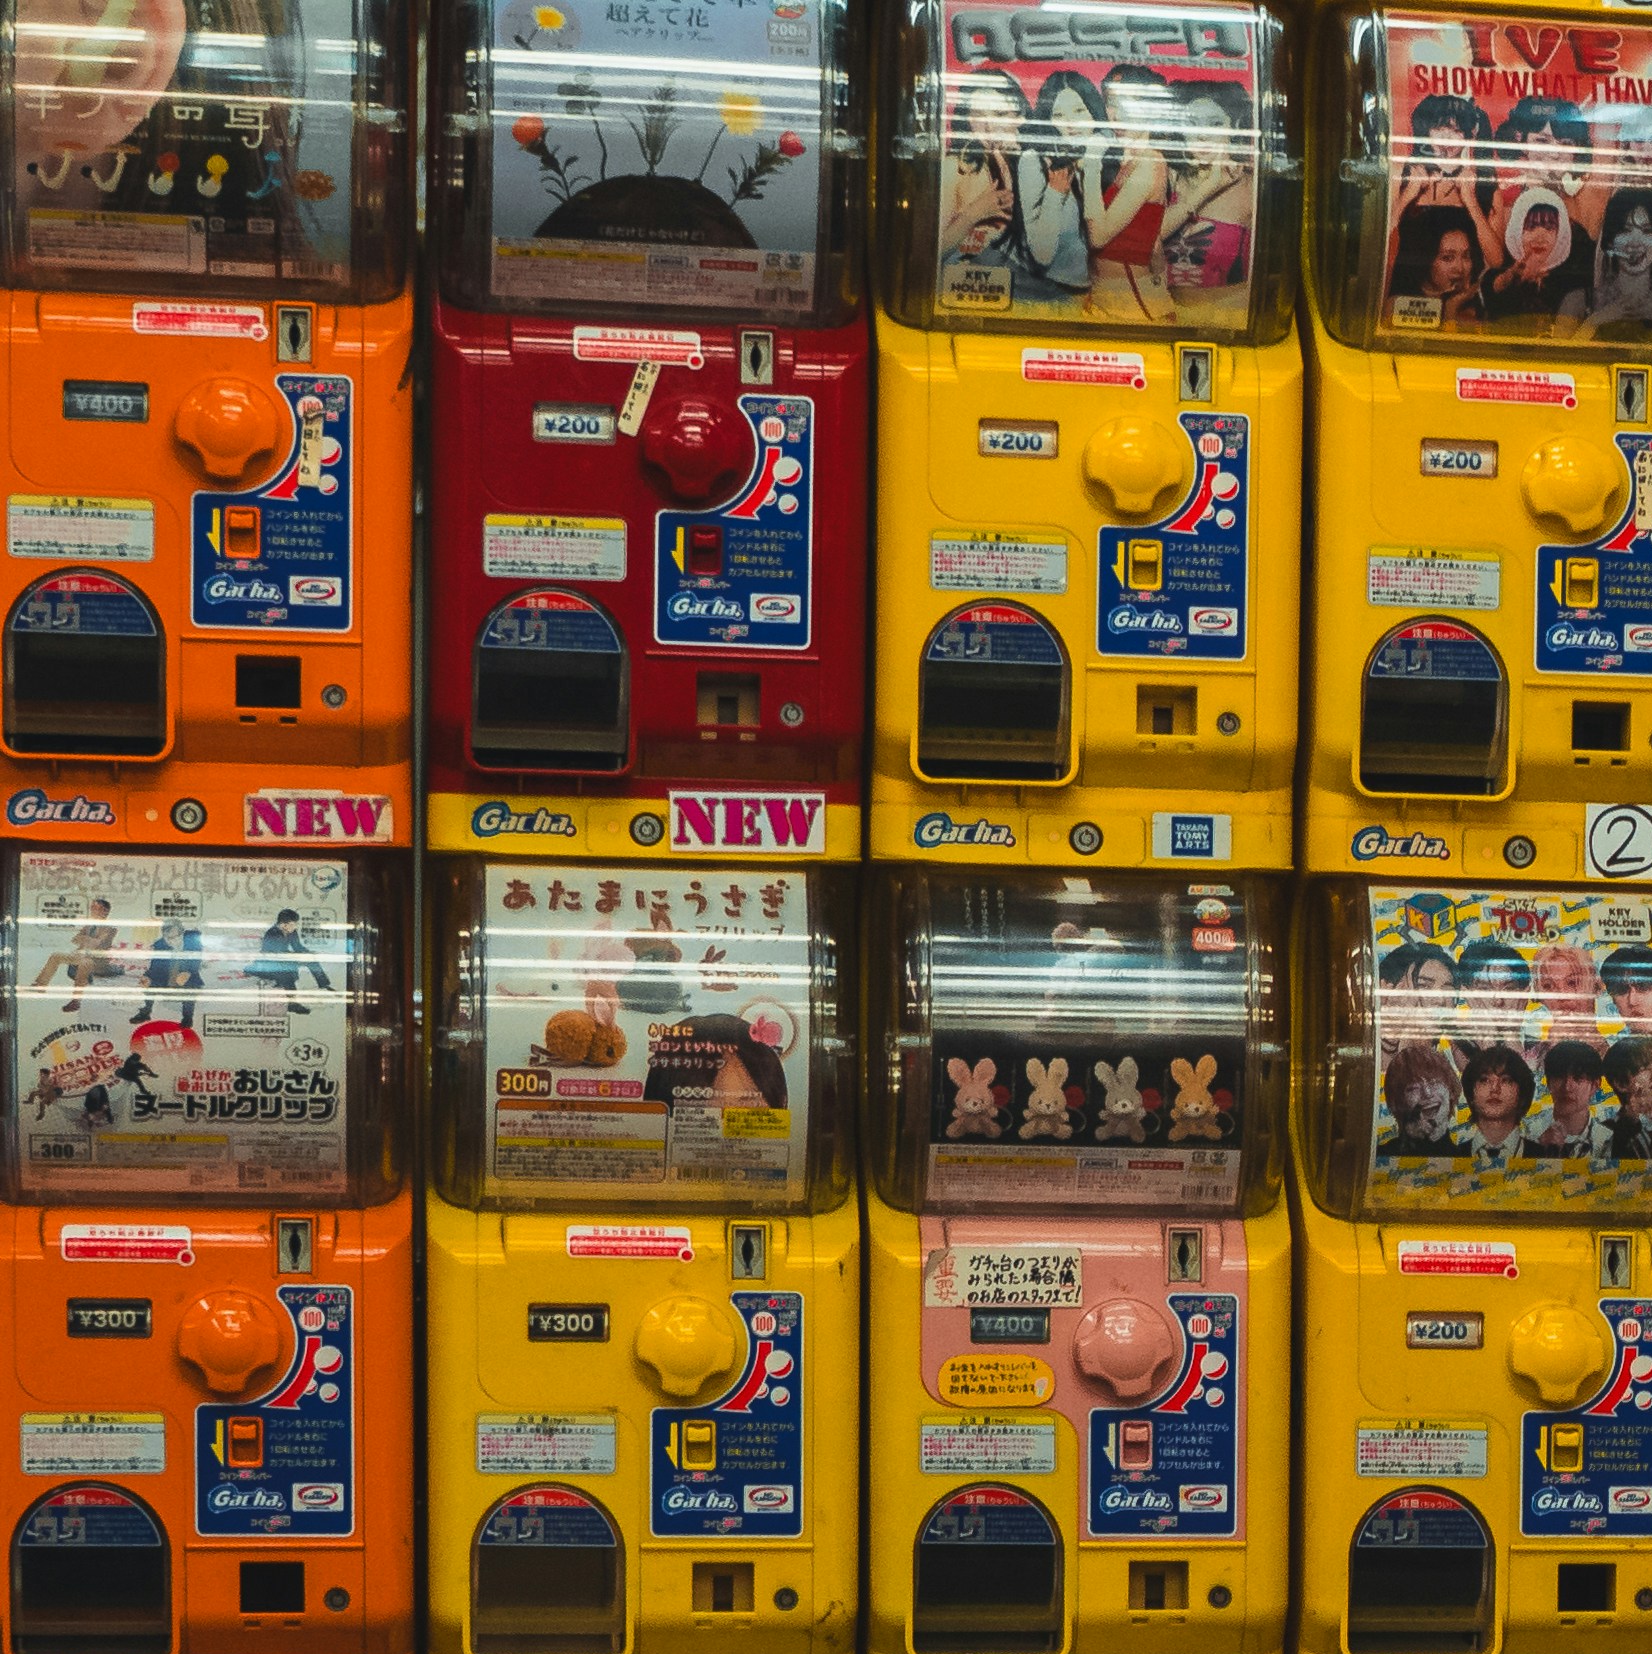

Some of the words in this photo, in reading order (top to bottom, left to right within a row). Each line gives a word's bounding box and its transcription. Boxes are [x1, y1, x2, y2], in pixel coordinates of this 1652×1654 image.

[1464, 21, 1623, 76] IVE
[1413, 64, 1500, 98] SHOW
[1503, 68, 1583, 101] WHAT
[74, 394, 134, 415] ¥400
[544, 417, 601, 436] ¥200
[988, 432, 1043, 452] ¥200
[1429, 451, 1483, 471] ¥200
[208, 576, 283, 604] Gacha.
[1109, 606, 1182, 633] Gacha.
[8, 792, 115, 824] Gacha.
[245, 797, 387, 838] NEW
[672, 799, 821, 845] NEW
[916, 815, 1017, 847] Gacha.
[502, 878, 791, 919] あたまにうさぎ
[1492, 908, 1549, 932] TOY
[1598, 919, 1645, 928] HOLDER
[233, 1069, 336, 1095] おじさん
[500, 1072, 549, 1092] 300円
[132, 1095, 336, 1122] ヌードルクリップ
[969, 1254, 1079, 1271] ガチャ台のつまりが
[80, 1310, 140, 1330] ¥300
[540, 1313, 596, 1333] ¥300
[981, 1317, 1034, 1333] ¥400
[1415, 1321, 1468, 1341] ¥200
[208, 1487, 284, 1513] Gacha.
[1101, 1487, 1173, 1514] Gacha.
